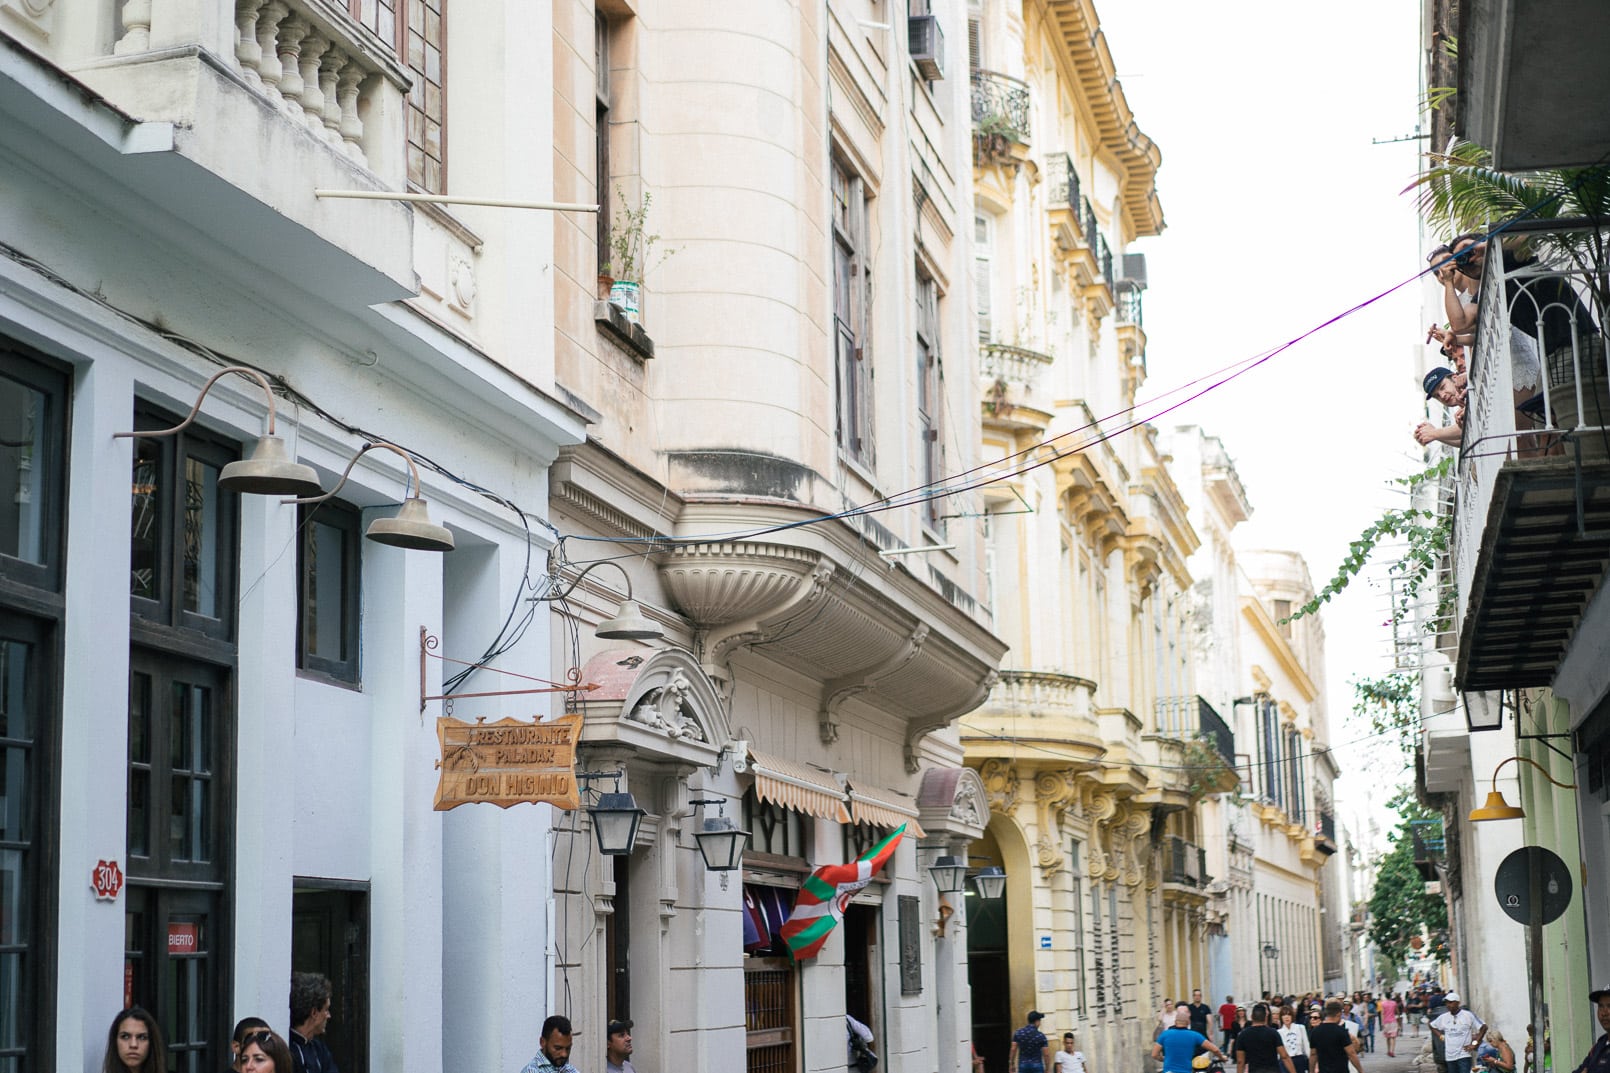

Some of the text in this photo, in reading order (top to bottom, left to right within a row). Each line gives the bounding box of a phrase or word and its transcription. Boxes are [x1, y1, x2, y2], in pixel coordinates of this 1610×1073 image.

[477, 727, 571, 745] RESTAURANTE
[495, 748, 555, 764] PALADAR
[465, 775, 569, 797] DON HIGINIO
[98, 866, 118, 891] 304
[168, 934, 194, 946] BIERTO
